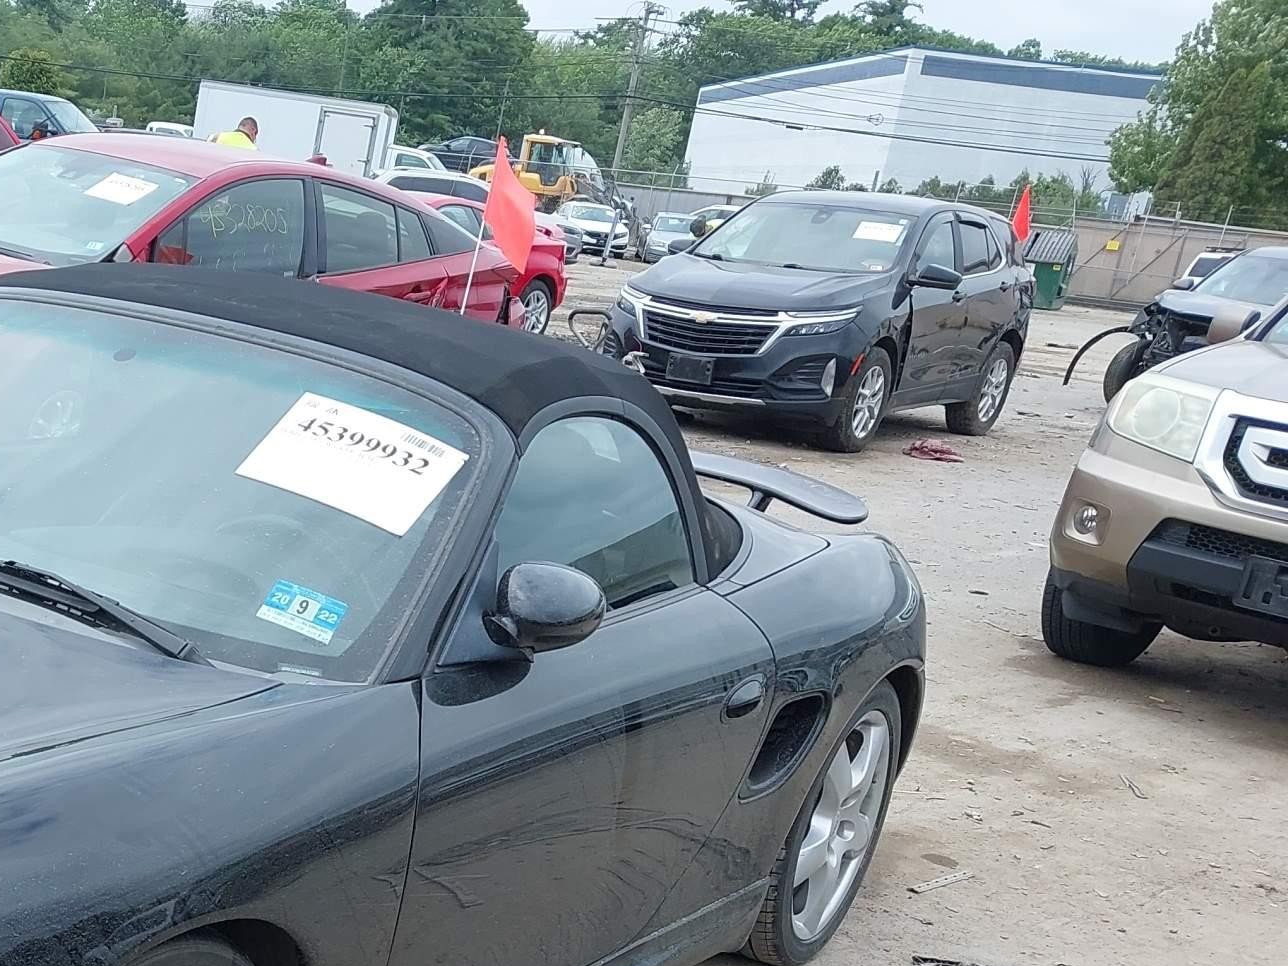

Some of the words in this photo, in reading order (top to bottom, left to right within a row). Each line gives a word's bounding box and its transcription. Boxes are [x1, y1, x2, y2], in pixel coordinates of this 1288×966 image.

[199, 202, 289, 239] 45328205
[296, 416, 431, 476] 45399932
[271, 591, 290, 605] 20
[295, 599, 310, 615] 9
[317, 609, 339, 625] 22
